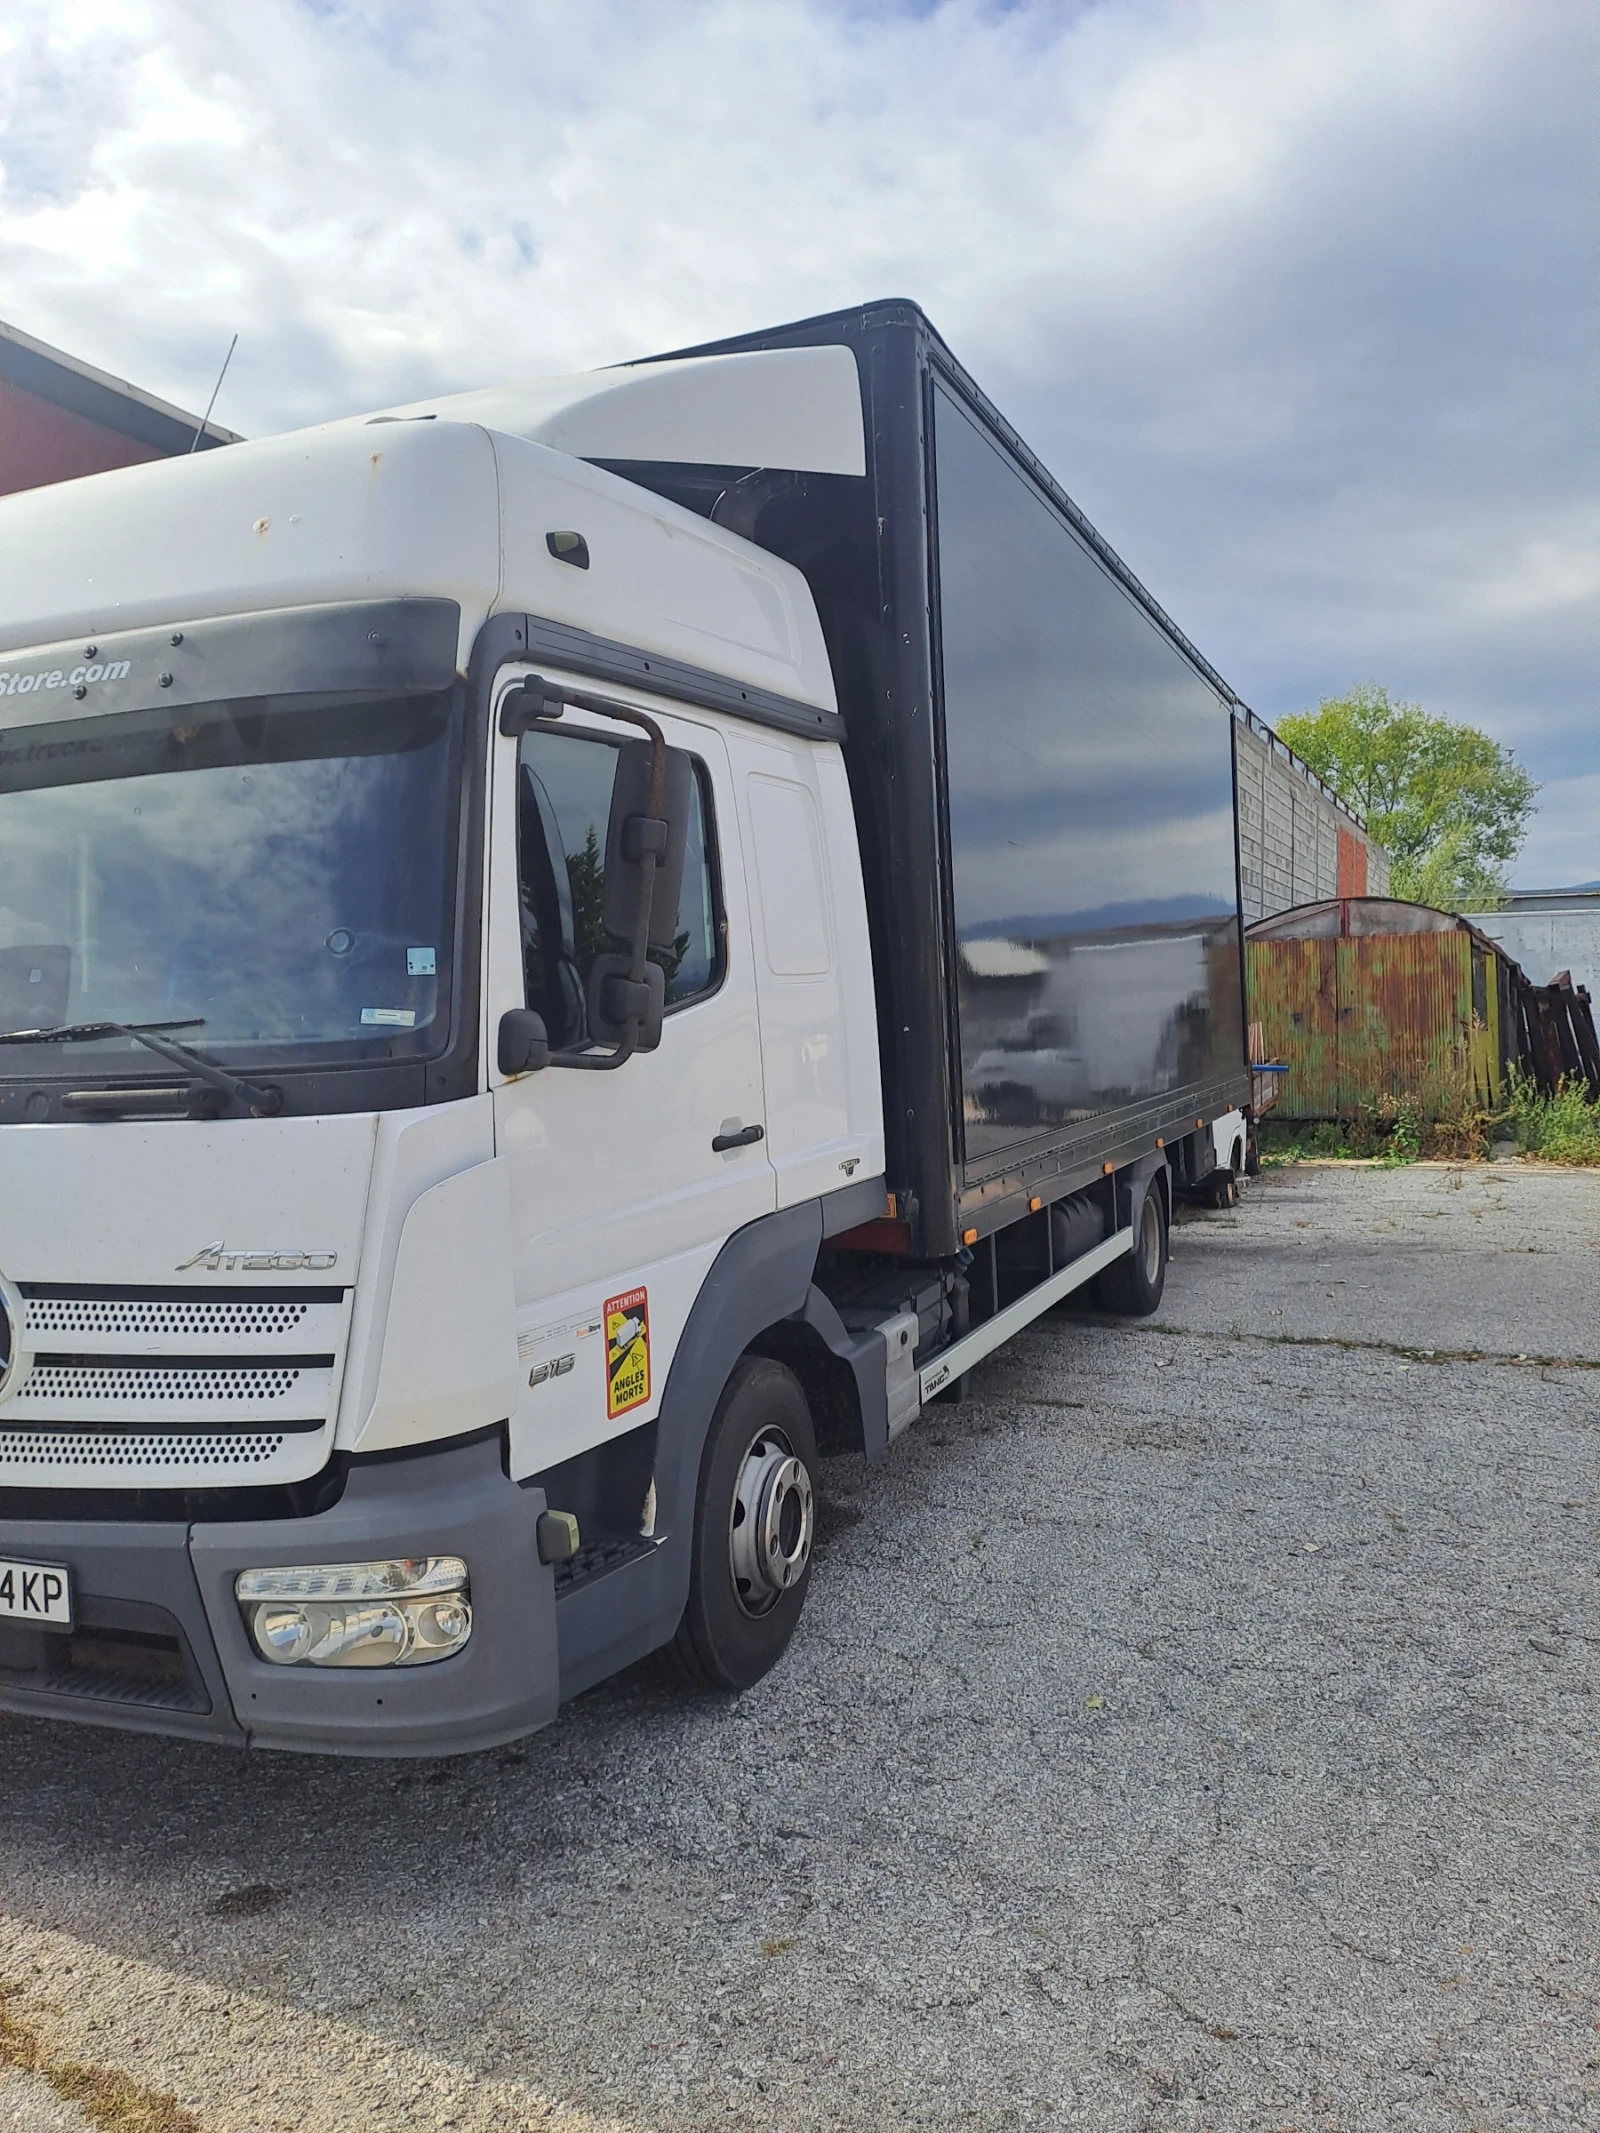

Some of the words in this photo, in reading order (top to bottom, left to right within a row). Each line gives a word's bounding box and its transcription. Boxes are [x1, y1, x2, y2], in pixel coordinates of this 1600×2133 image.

[0, 660, 131, 695] Store.com
[607, 1291, 645, 1313] ATTENTION
[614, 1370, 645, 1393] ANGLES
[616, 1383, 644, 1405] MORTS
